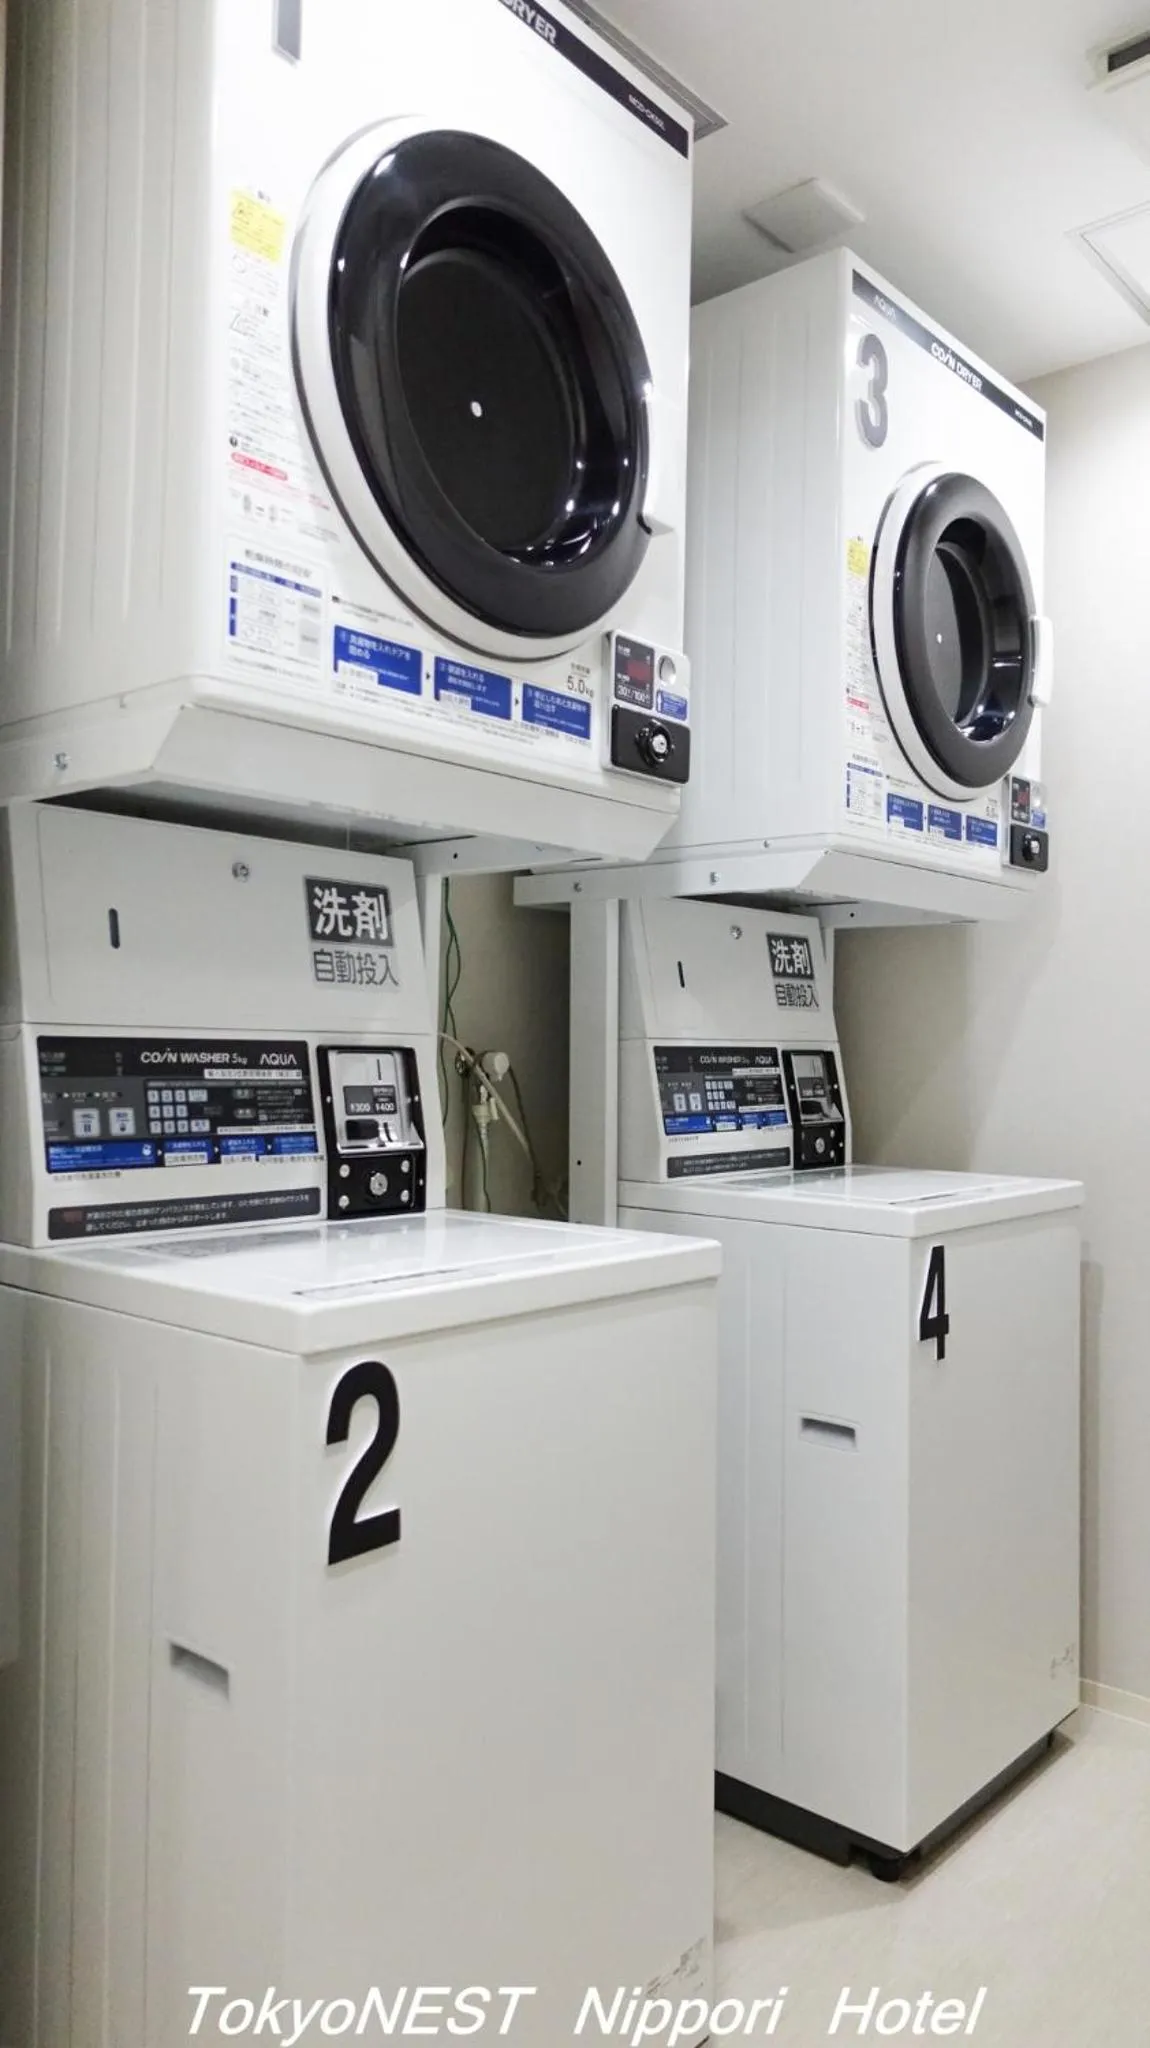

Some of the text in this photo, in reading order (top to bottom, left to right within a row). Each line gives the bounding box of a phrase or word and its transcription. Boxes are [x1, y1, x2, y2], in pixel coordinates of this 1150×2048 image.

[856, 333, 888, 450] 3
[956, 361, 983, 392] DRYER
[313, 886, 388, 940] 洗剤
[313, 948, 399, 986] 自動投入
[771, 939, 811, 975] 洗剤
[140, 1047, 177, 1063] COIN
[180, 1052, 230, 1064] WASHER
[260, 1053, 297, 1065] AQUA
[755, 1056, 774, 1065] AQUA
[919, 1245, 949, 1360] 4
[326, 1360, 401, 1566] 2
